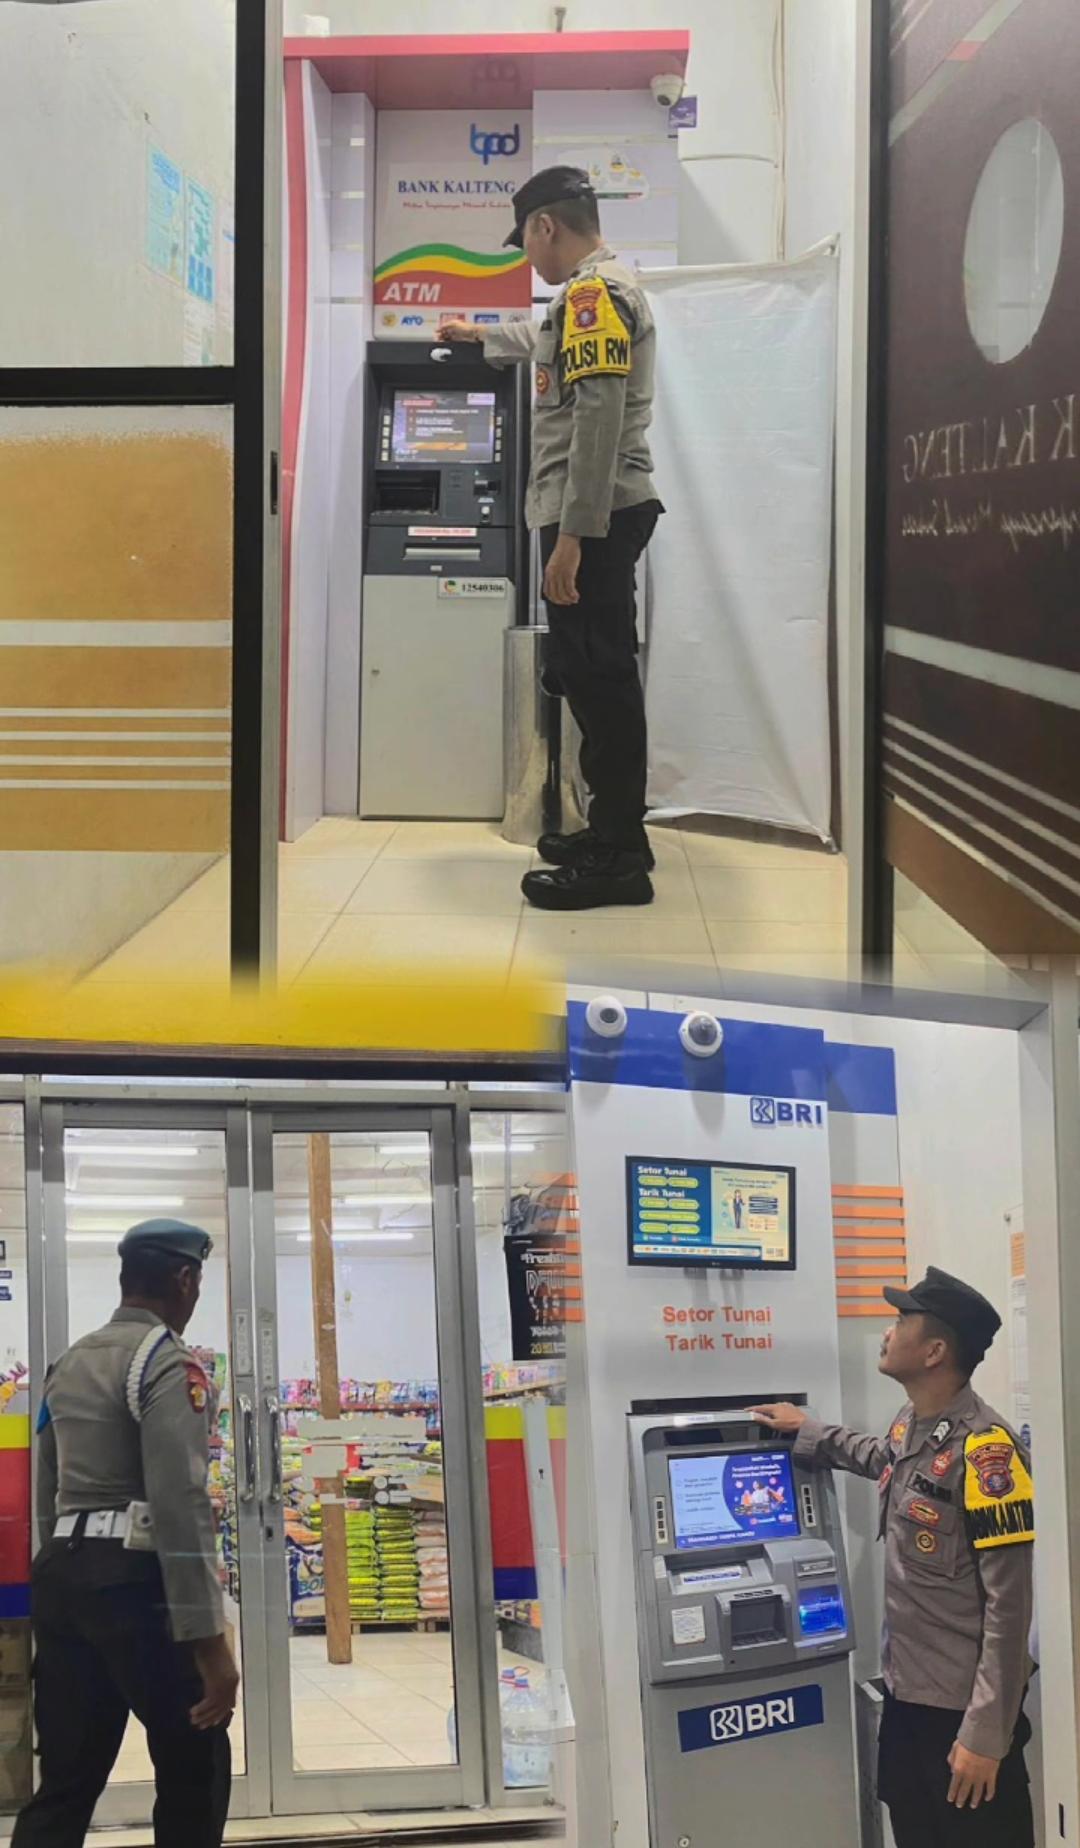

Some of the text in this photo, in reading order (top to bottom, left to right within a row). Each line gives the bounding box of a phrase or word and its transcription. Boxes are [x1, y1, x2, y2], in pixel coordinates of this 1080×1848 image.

[398, 181, 516, 195] BANK KALTENG
[382, 282, 442, 303] ATM
[605, 337, 629, 366] RW
[776, 1102, 823, 1127] BRI
[638, 1166, 662, 1175] Setor
[638, 1188, 660, 1196] Tarik
[662, 1305, 772, 1325] Setor Tunai
[665, 1334, 773, 1352] Tarik Tunai
[745, 1696, 796, 1732] BRI
